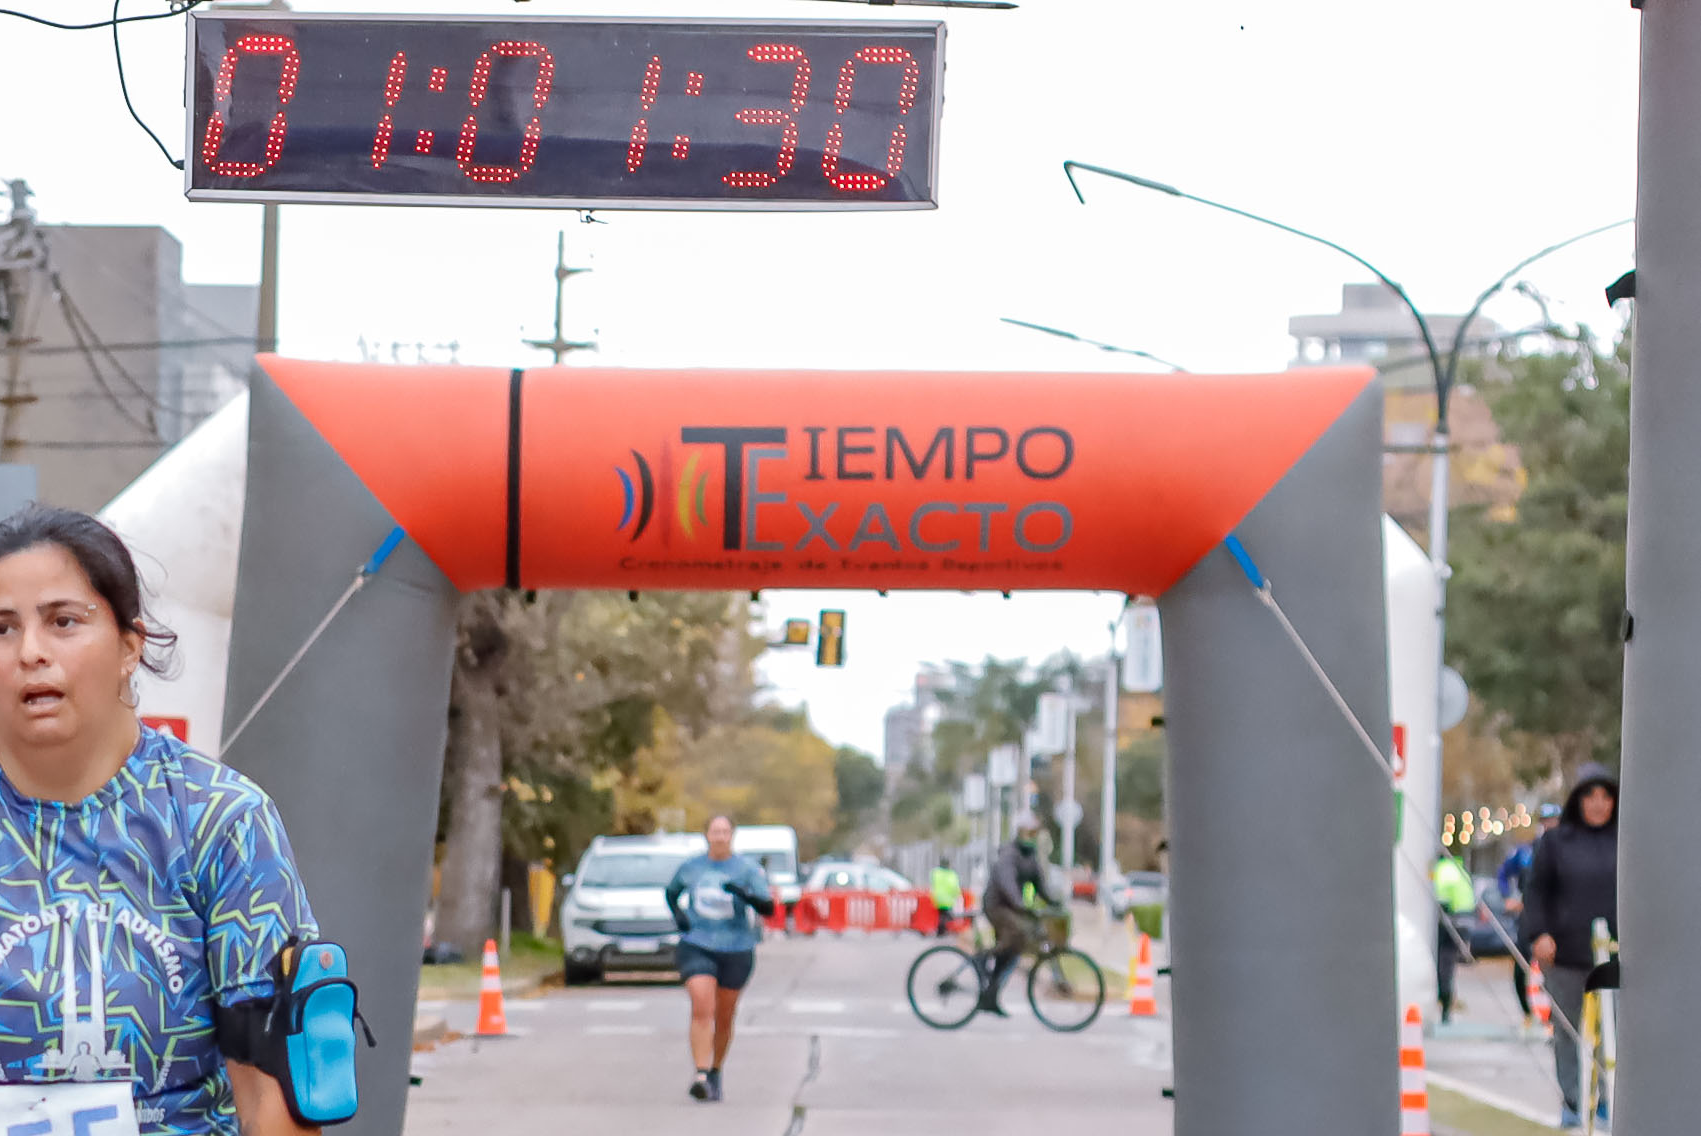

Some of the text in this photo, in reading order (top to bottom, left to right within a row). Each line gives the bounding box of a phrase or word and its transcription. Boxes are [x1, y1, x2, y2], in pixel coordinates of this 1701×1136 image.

[201, 34, 921, 192] 01:01:30
[681, 426, 1075, 551] TIEMPO
[744, 448, 1074, 552] EXACTO
[86, 903, 109, 922] EL
[115, 908, 184, 994] AUTISMO
